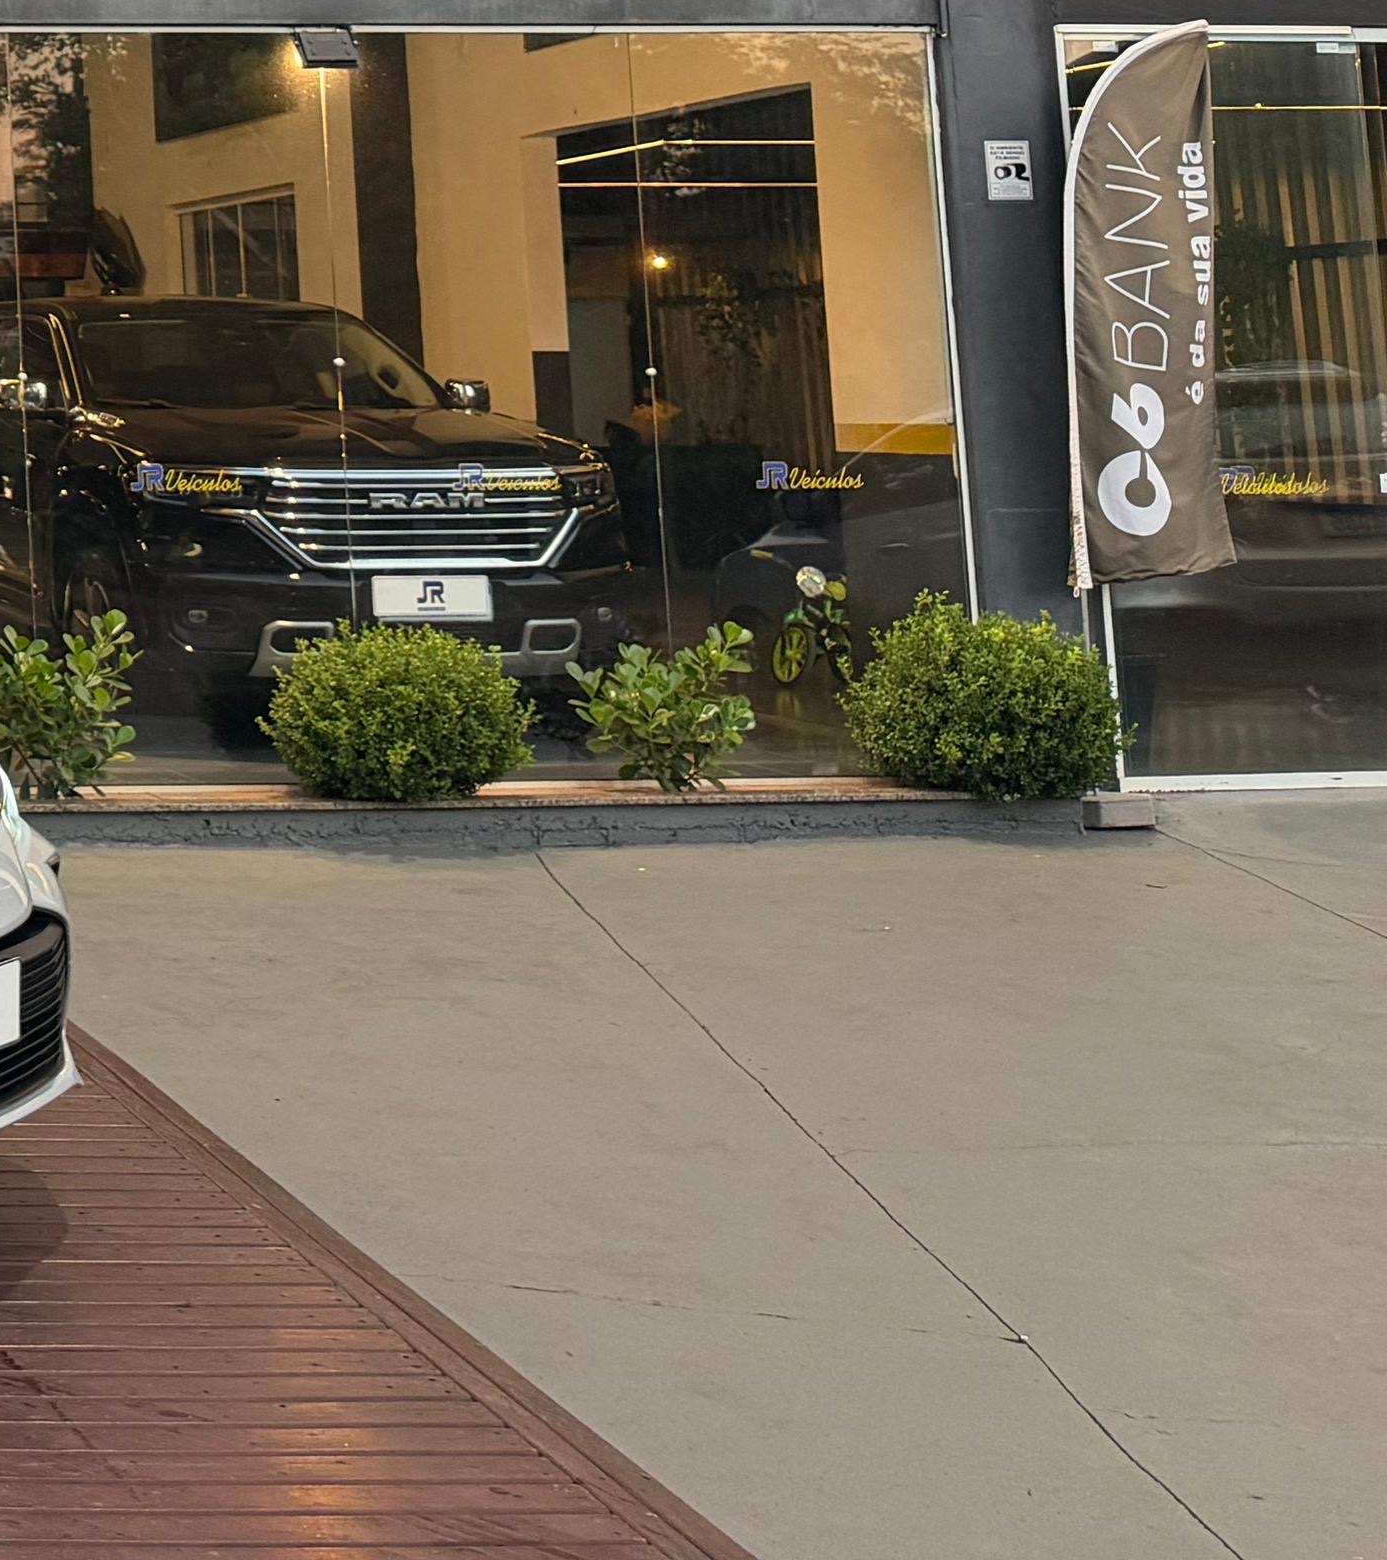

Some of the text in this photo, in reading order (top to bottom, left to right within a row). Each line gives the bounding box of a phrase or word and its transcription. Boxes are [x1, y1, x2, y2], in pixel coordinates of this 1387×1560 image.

[1177, 141, 1210, 223] vida
[1190, 236, 1212, 306] sua
[1098, 122, 1172, 536] C6 BANK
[1189, 320, 1206, 368] da
[130, 463, 165, 492] JR
[452, 463, 484, 491] JR
[756, 461, 865, 489] JR Veículos
[369, 492, 485, 509] RAM
[417, 581, 445, 604] JR
